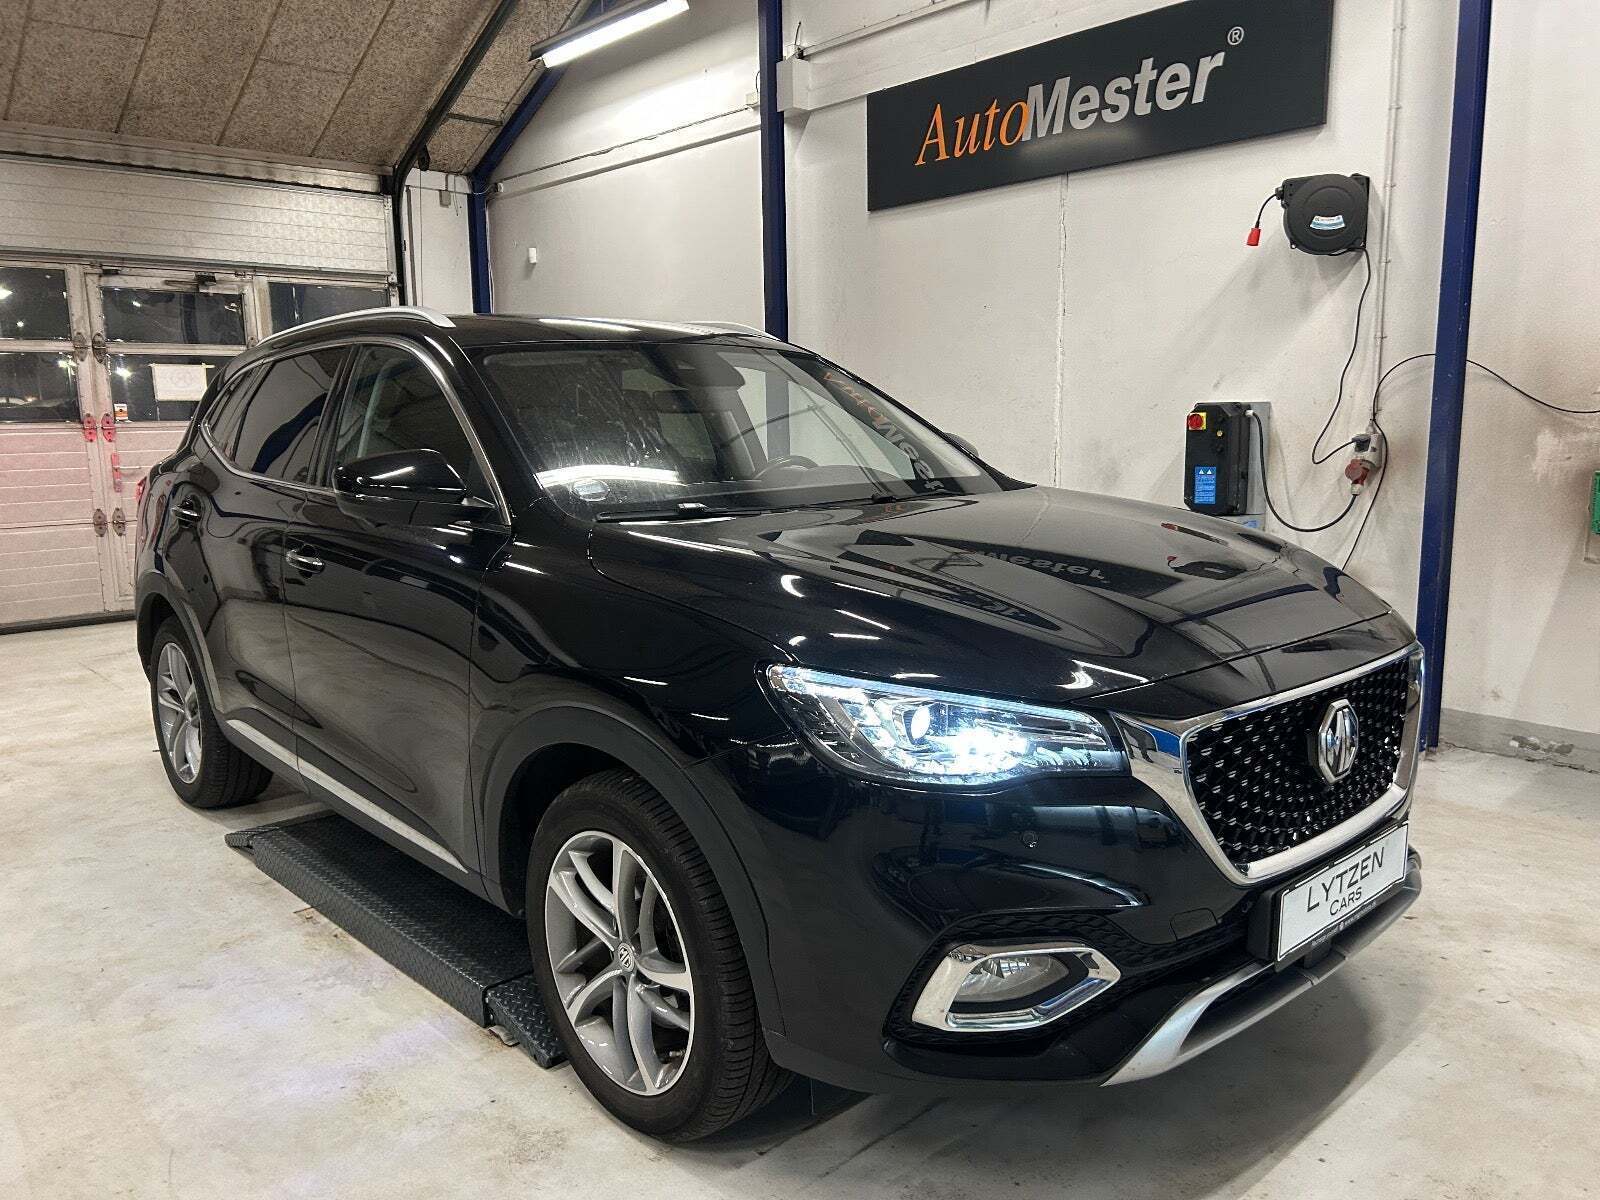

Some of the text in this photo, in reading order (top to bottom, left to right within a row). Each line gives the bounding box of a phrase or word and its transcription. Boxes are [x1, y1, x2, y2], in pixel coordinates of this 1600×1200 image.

[914, 52, 1226, 166] AutoMester
[1325, 706, 1357, 775] MG
[1307, 846, 1384, 913] LYTZEN
[1329, 886, 1362, 916] CARS
